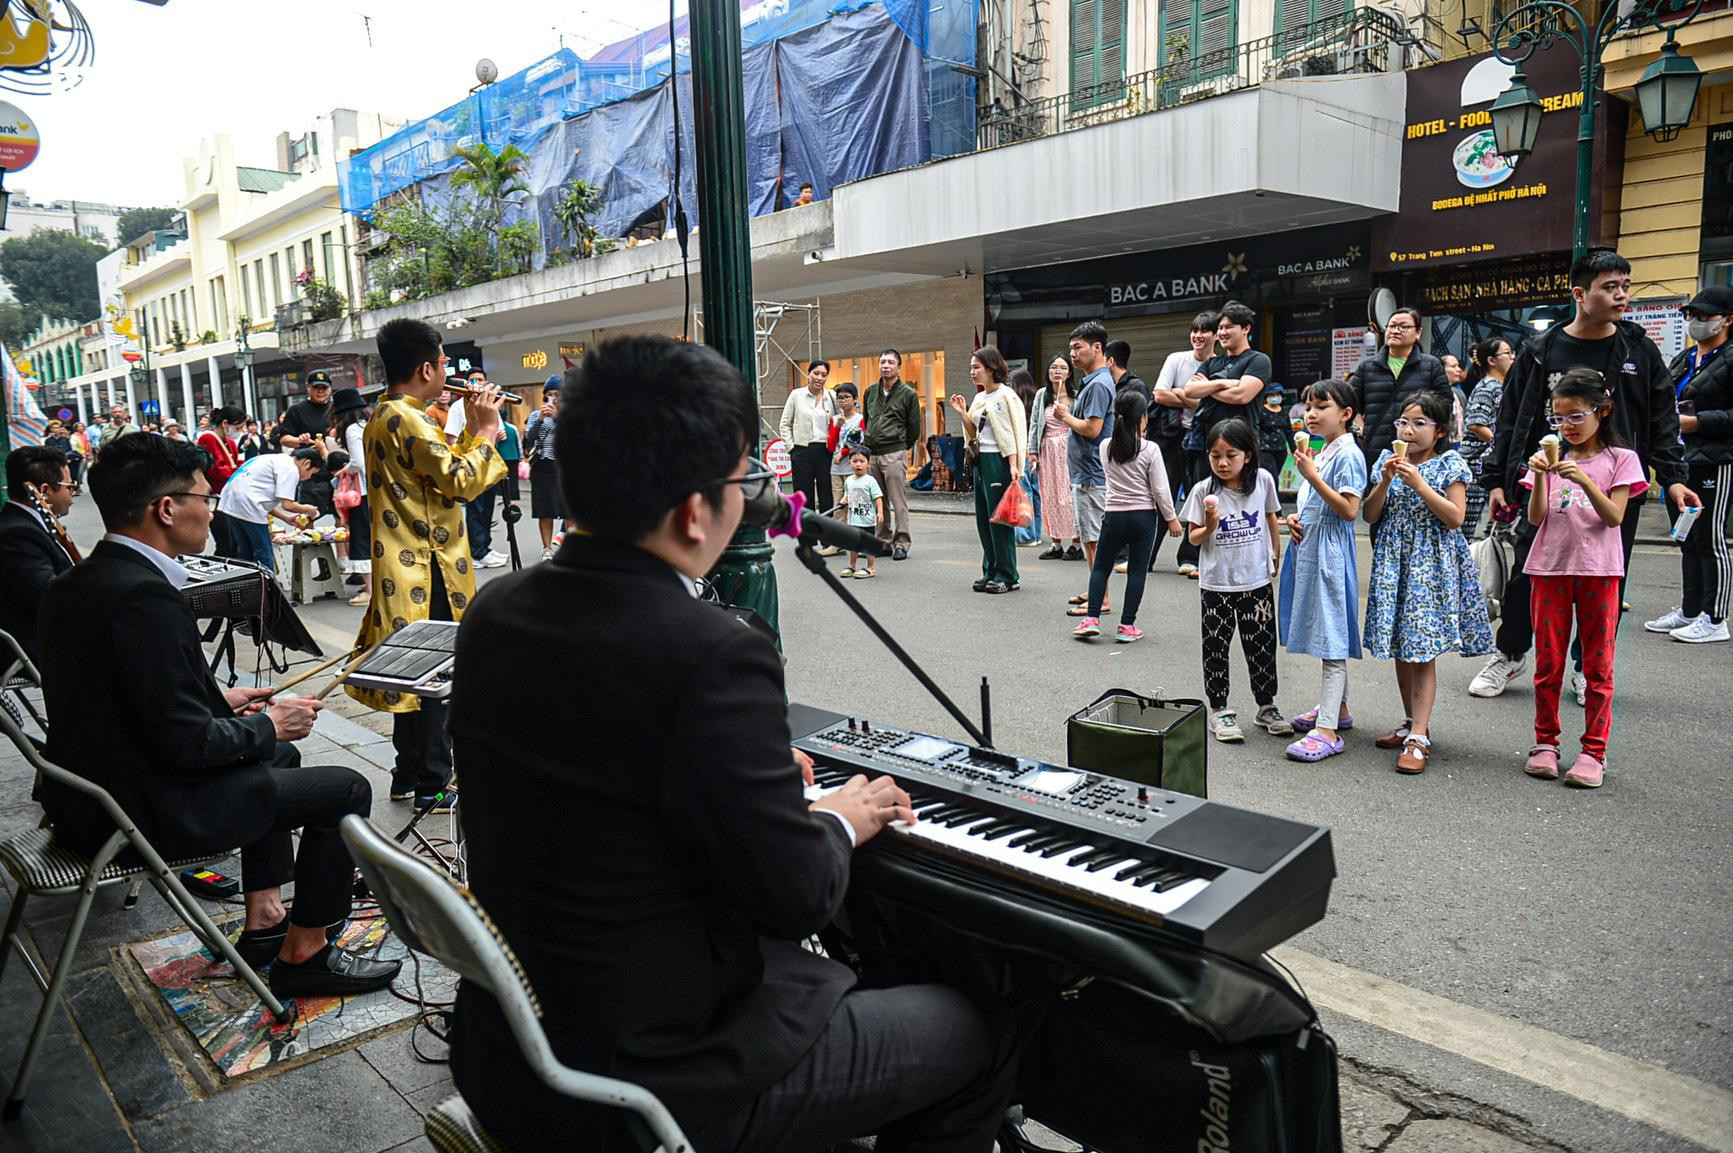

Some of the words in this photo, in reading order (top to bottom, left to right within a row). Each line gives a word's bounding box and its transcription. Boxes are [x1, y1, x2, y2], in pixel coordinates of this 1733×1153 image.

[1407, 119, 1447, 139] HOTEL
[1432, 196, 1463, 210] BODEGA
[1475, 188, 1498, 204] NHẤT
[1498, 185, 1517, 200] PHỞ
[1517, 184, 1530, 198] HÀ
[1530, 182, 1547, 197] NỘI
[1445, 247, 1466, 256] street
[1278, 262, 1302, 275] BAC
[1304, 261, 1314, 271] A
[1316, 257, 1350, 270] BANK
[1111, 283, 1148, 303] BAC
[1153, 281, 1167, 299] A
[1172, 274, 1228, 297] BANK
[1536, 271, 1551, 291] CÀ
[1191, 1061, 1231, 1153] Roland
